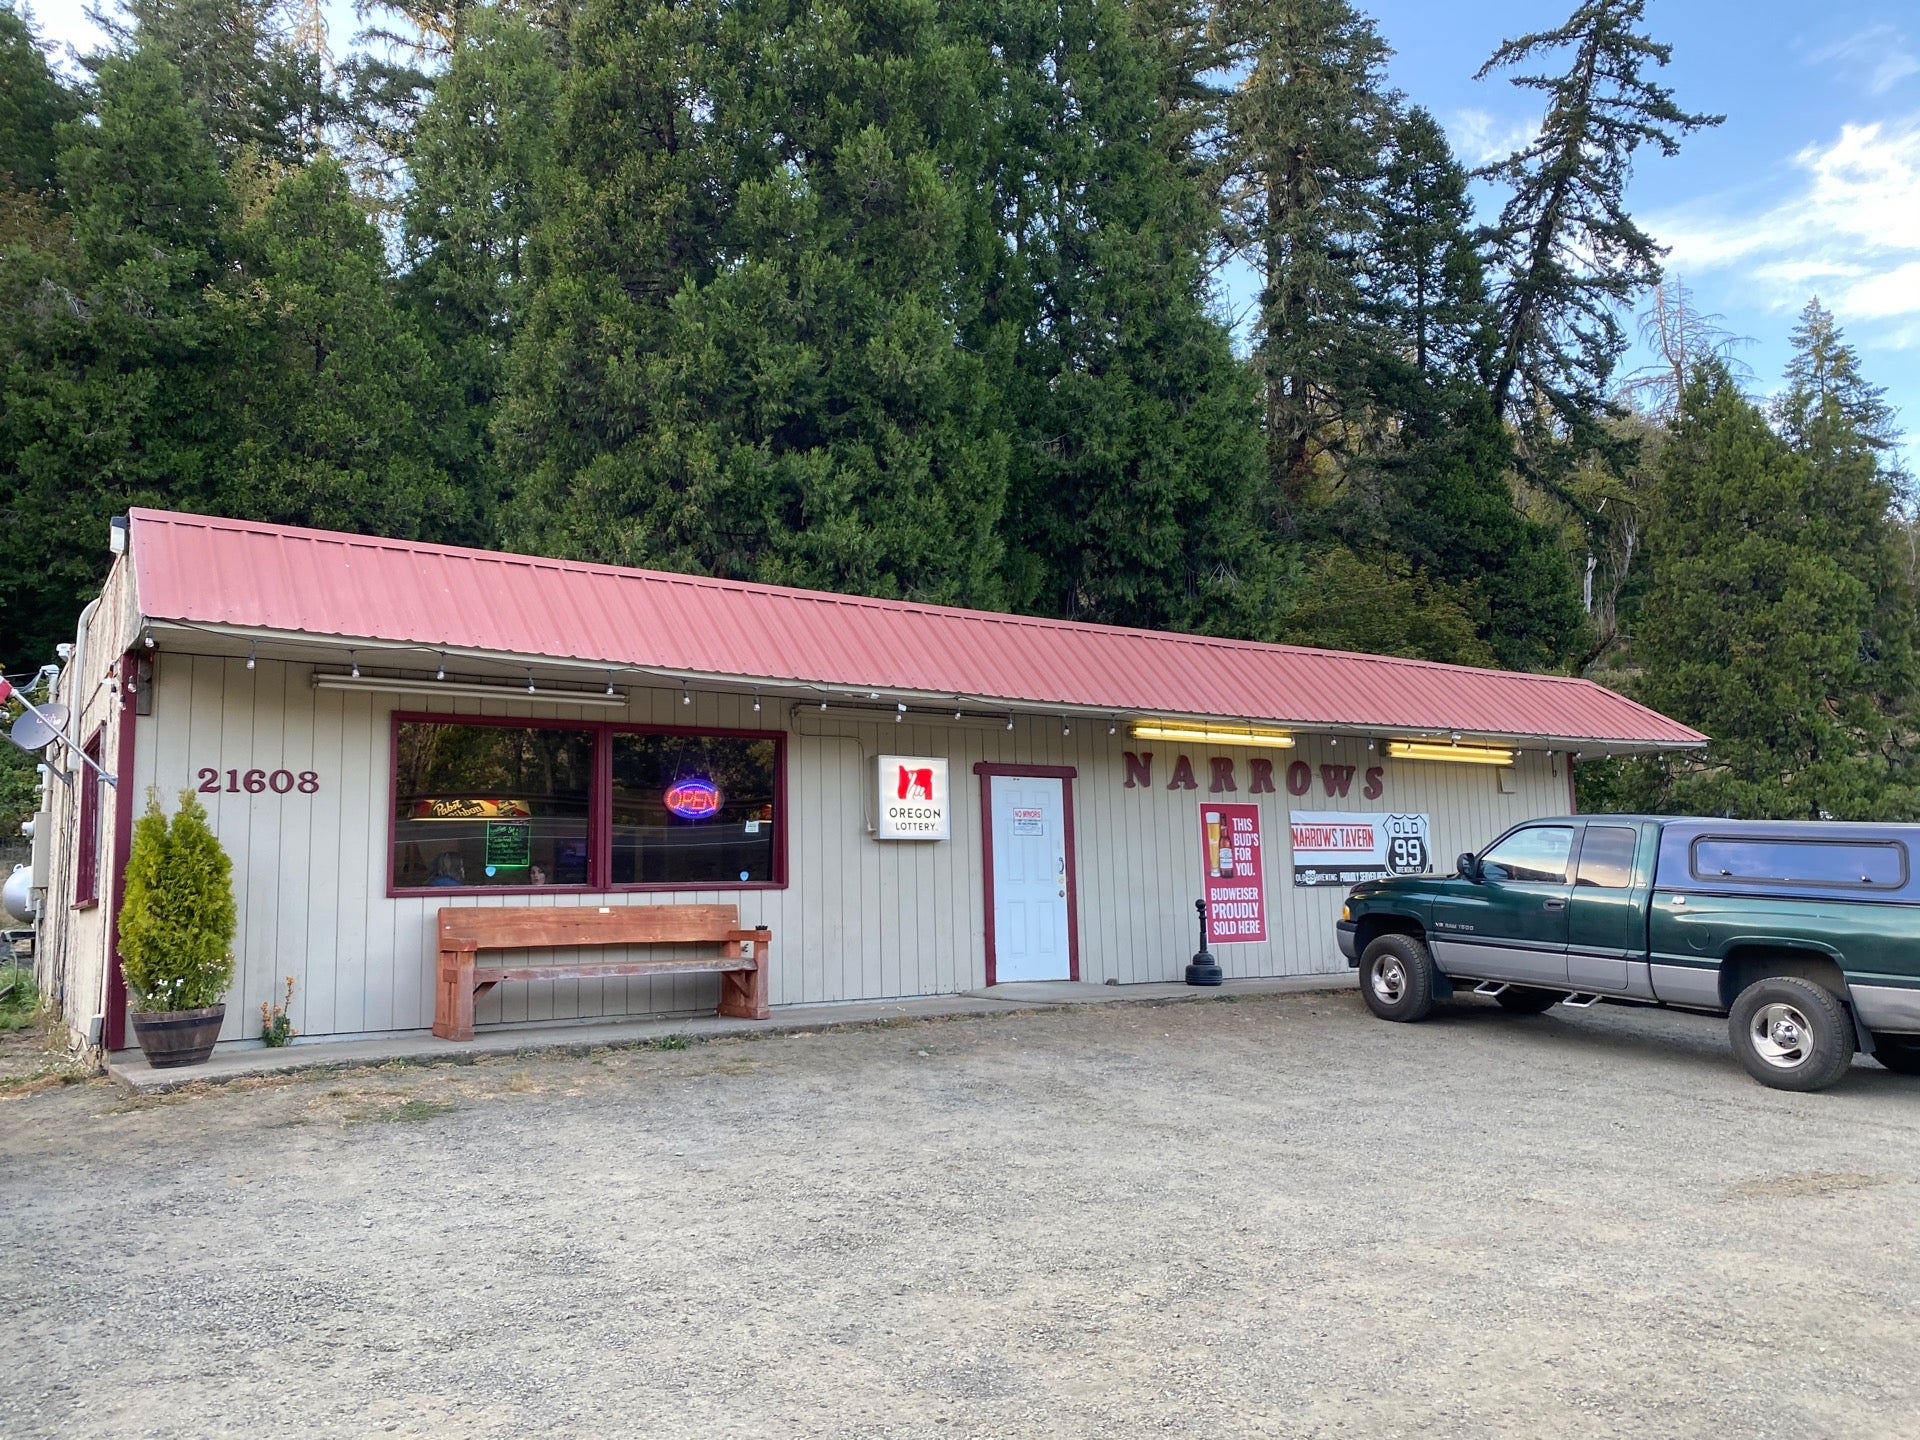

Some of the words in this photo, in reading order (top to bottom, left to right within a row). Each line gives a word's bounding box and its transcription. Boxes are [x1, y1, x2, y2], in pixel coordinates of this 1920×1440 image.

[198, 768, 320, 794] 21608
[1123, 752, 1384, 801] NARROWS
[667, 789, 720, 810] OPEN
[432, 800, 463, 816] Pabst
[889, 807, 941, 819] OREGON
[1014, 810, 1022, 819] NO
[1023, 810, 1041, 819] MINORS
[895, 822, 936, 831] LOTTERY
[1232, 817, 1253, 832] THIS
[1393, 821, 1419, 835] OLD
[1233, 833, 1259, 847] BUD'S
[1291, 828, 1338, 847] NARROWS
[1339, 828, 1374, 847] TAVERN
[1234, 847, 1252, 861] FOR
[1394, 839, 1421, 866] 99
[1235, 862, 1256, 876] YOU.
[1295, 873, 1306, 882] OLD
[1307, 873, 1315, 882] 99
[1315, 873, 1338, 881] BREWING
[1339, 872, 1359, 882] PROUDLY
[1360, 872, 1377, 881] SERVED
[1210, 887, 1259, 901] BUDWEISER
[1212, 902, 1259, 919] PROUDLY
[1213, 920, 1237, 935] SOLD
[1238, 920, 1260, 934] HERE
